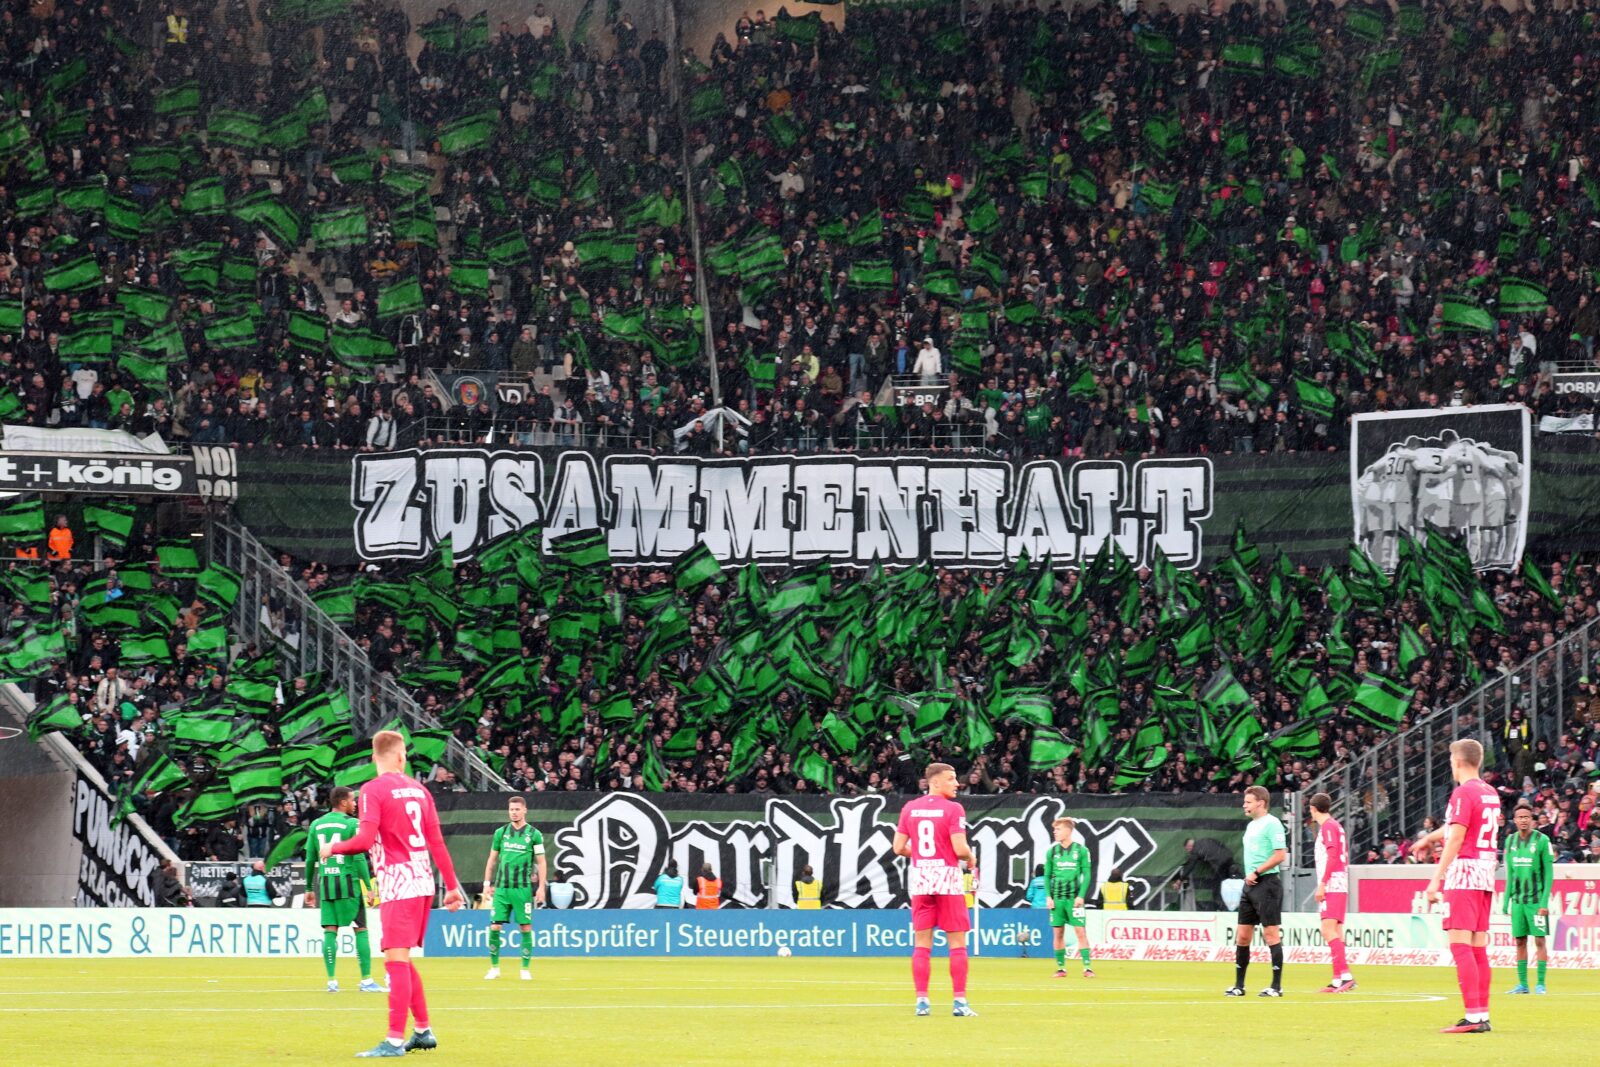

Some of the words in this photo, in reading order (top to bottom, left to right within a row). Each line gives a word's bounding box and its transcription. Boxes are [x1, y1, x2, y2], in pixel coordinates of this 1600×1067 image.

[58, 459, 182, 491] könig
[353, 449, 1212, 569] ZUSAMMENHALT
[405, 801, 426, 848] 3
[917, 819, 936, 858] 8
[554, 791, 1157, 909] Nordkre
[0, 923, 113, 954] EHRENS
[129, 916, 152, 954] &
[168, 914, 300, 954] PARTNER
[306, 934, 354, 954] mB
[678, 922, 846, 948] Steuerberater
[1111, 927, 1163, 941] CARLO
[1168, 927, 1212, 942] ERBA
[1289, 928, 1301, 946] IN
[1344, 928, 1394, 948] CHOICE
[1143, 945, 1209, 961] WeberHaus
[1365, 949, 1440, 965] WeberHaus
